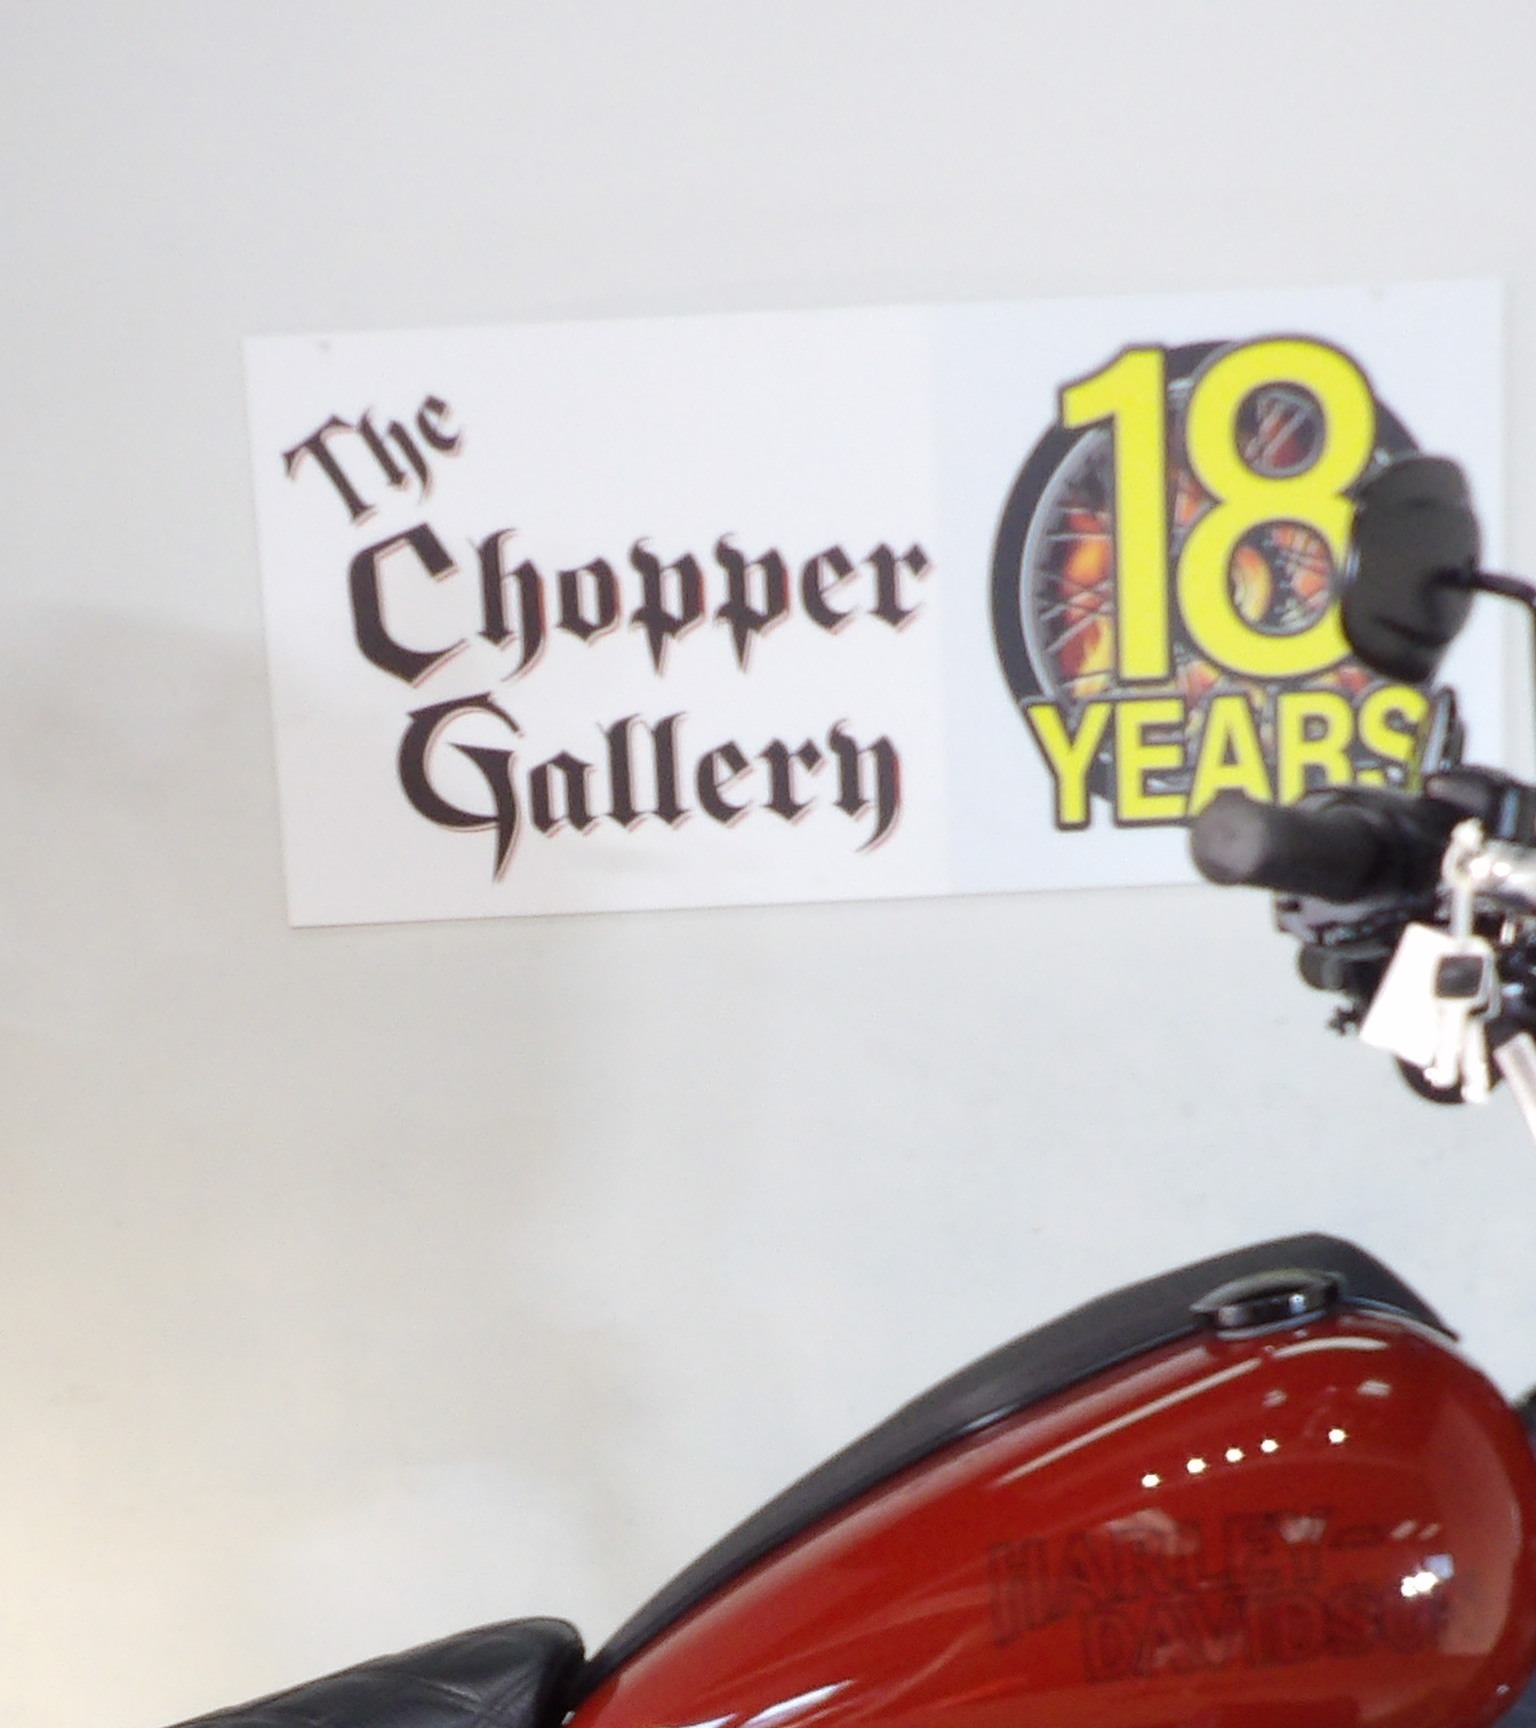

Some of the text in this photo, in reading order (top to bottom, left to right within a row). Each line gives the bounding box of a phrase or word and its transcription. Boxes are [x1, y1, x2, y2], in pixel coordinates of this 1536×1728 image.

[282, 394, 464, 523] The
[1058, 333, 1378, 681] 18
[346, 520, 931, 688] Chopper
[397, 690, 904, 882] Gallery
[1028, 684, 1431, 828] YEARS
[1077, 1570, 1484, 1684] DAVIDSO
